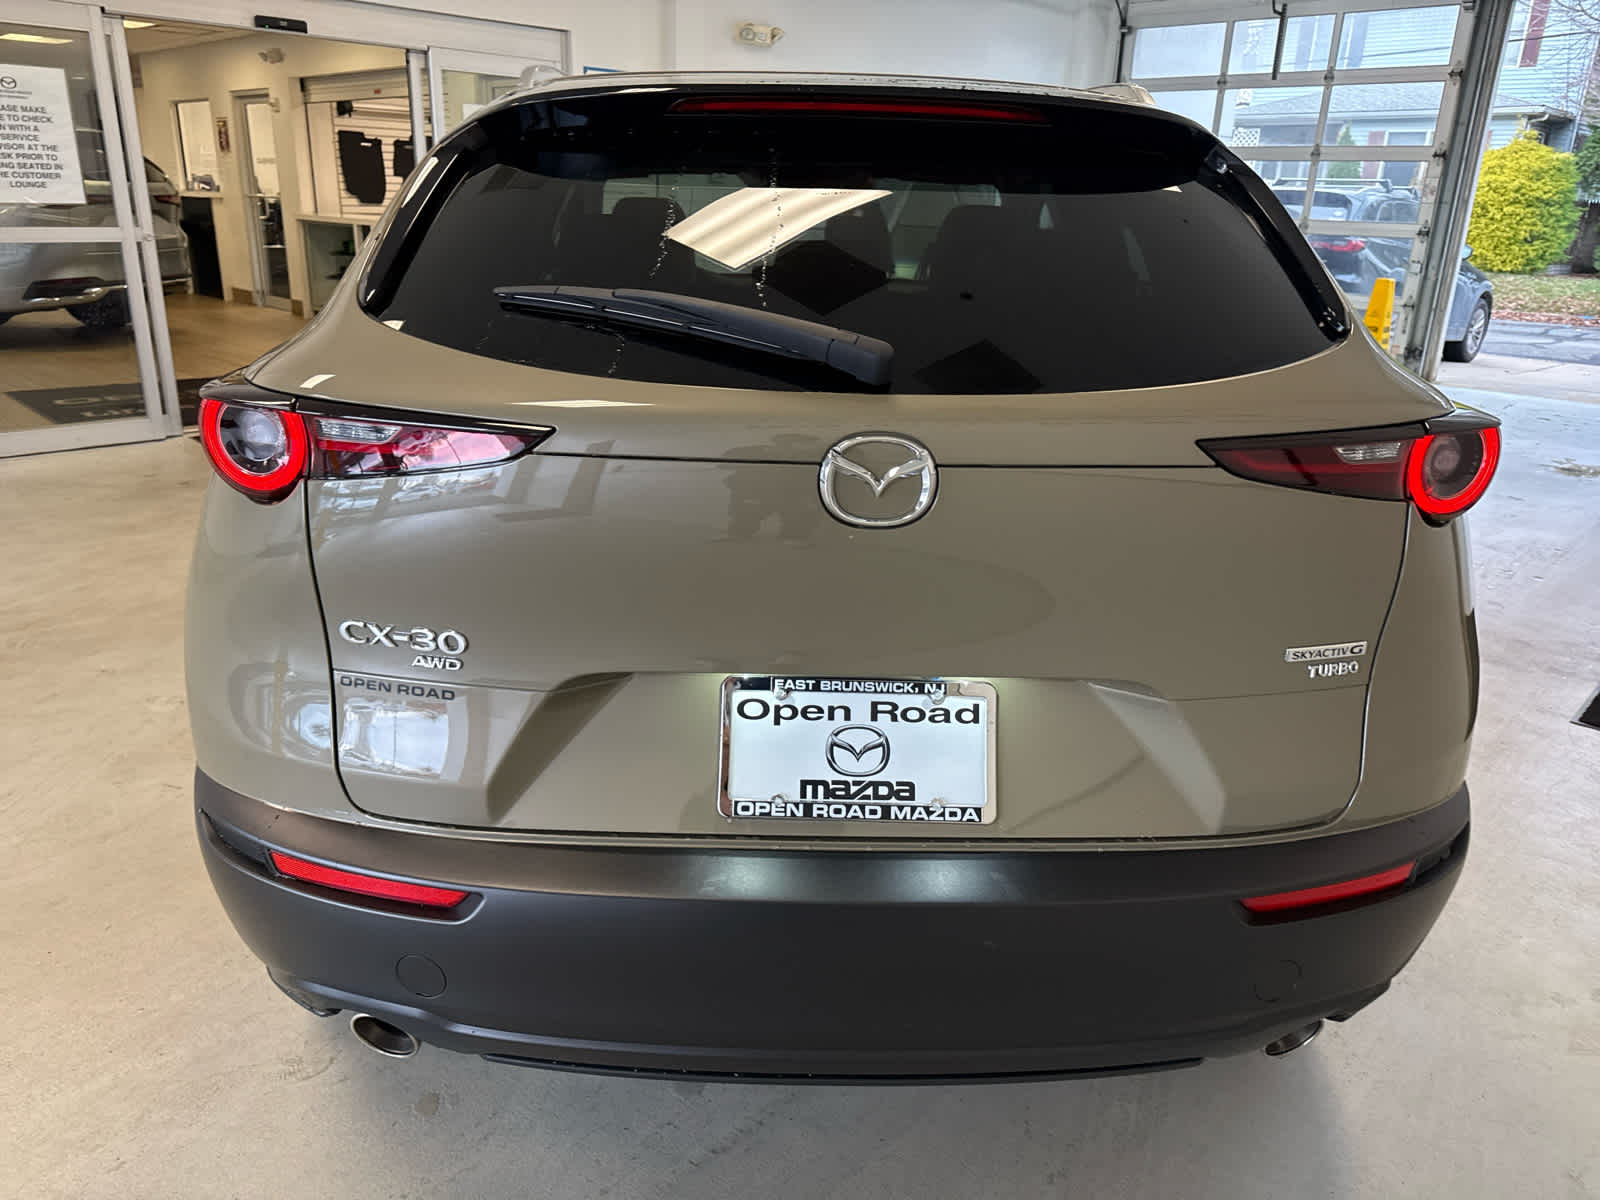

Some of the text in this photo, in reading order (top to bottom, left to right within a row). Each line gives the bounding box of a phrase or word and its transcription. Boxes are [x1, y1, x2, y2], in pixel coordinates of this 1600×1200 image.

[20, 105, 47, 114] MAKE
[6, 114, 20, 122] TO
[21, 115, 54, 123] CHECK
[0, 133, 40, 142] SERVICE
[40, 144, 59, 152] THE
[17, 162, 52, 170] SEATED
[11, 171, 61, 180] CUSTOMER
[9, 180, 48, 188] LOUNGE
[339, 619, 468, 655] CX-30
[411, 655, 464, 671] AWD
[1307, 660, 1360, 678] TURBO
[340, 676, 456, 701] OPEN ROAD
[774, 679, 815, 691] EAST
[820, 680, 919, 693] BRUNSWICK,
[736, 698, 980, 725] Open Road
[799, 779, 916, 801] mazda
[736, 801, 980, 822] OPEN ROAD MAZDA
